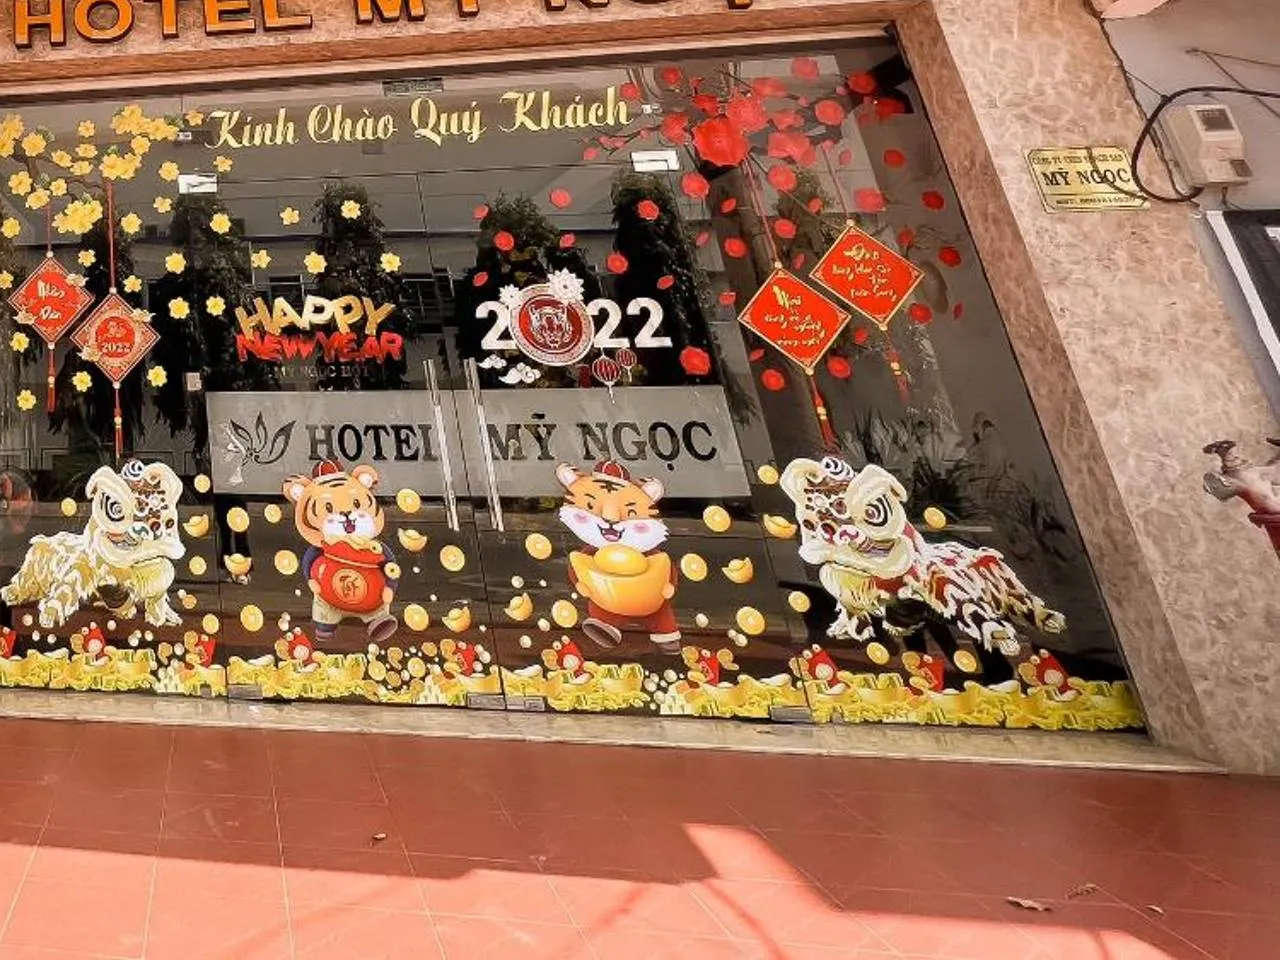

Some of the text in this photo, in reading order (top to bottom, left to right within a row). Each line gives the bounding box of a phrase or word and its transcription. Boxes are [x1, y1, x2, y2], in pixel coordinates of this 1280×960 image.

[204, 86, 634, 149] Kính Chào Quý Khách
[1041, 167, 1071, 186] MỸ
[235, 294, 397, 340] HAPPY
[236, 331, 405, 364] NEW YEAR
[484, 412, 557, 461] MỸ
[576, 420, 718, 472] NGỌC
